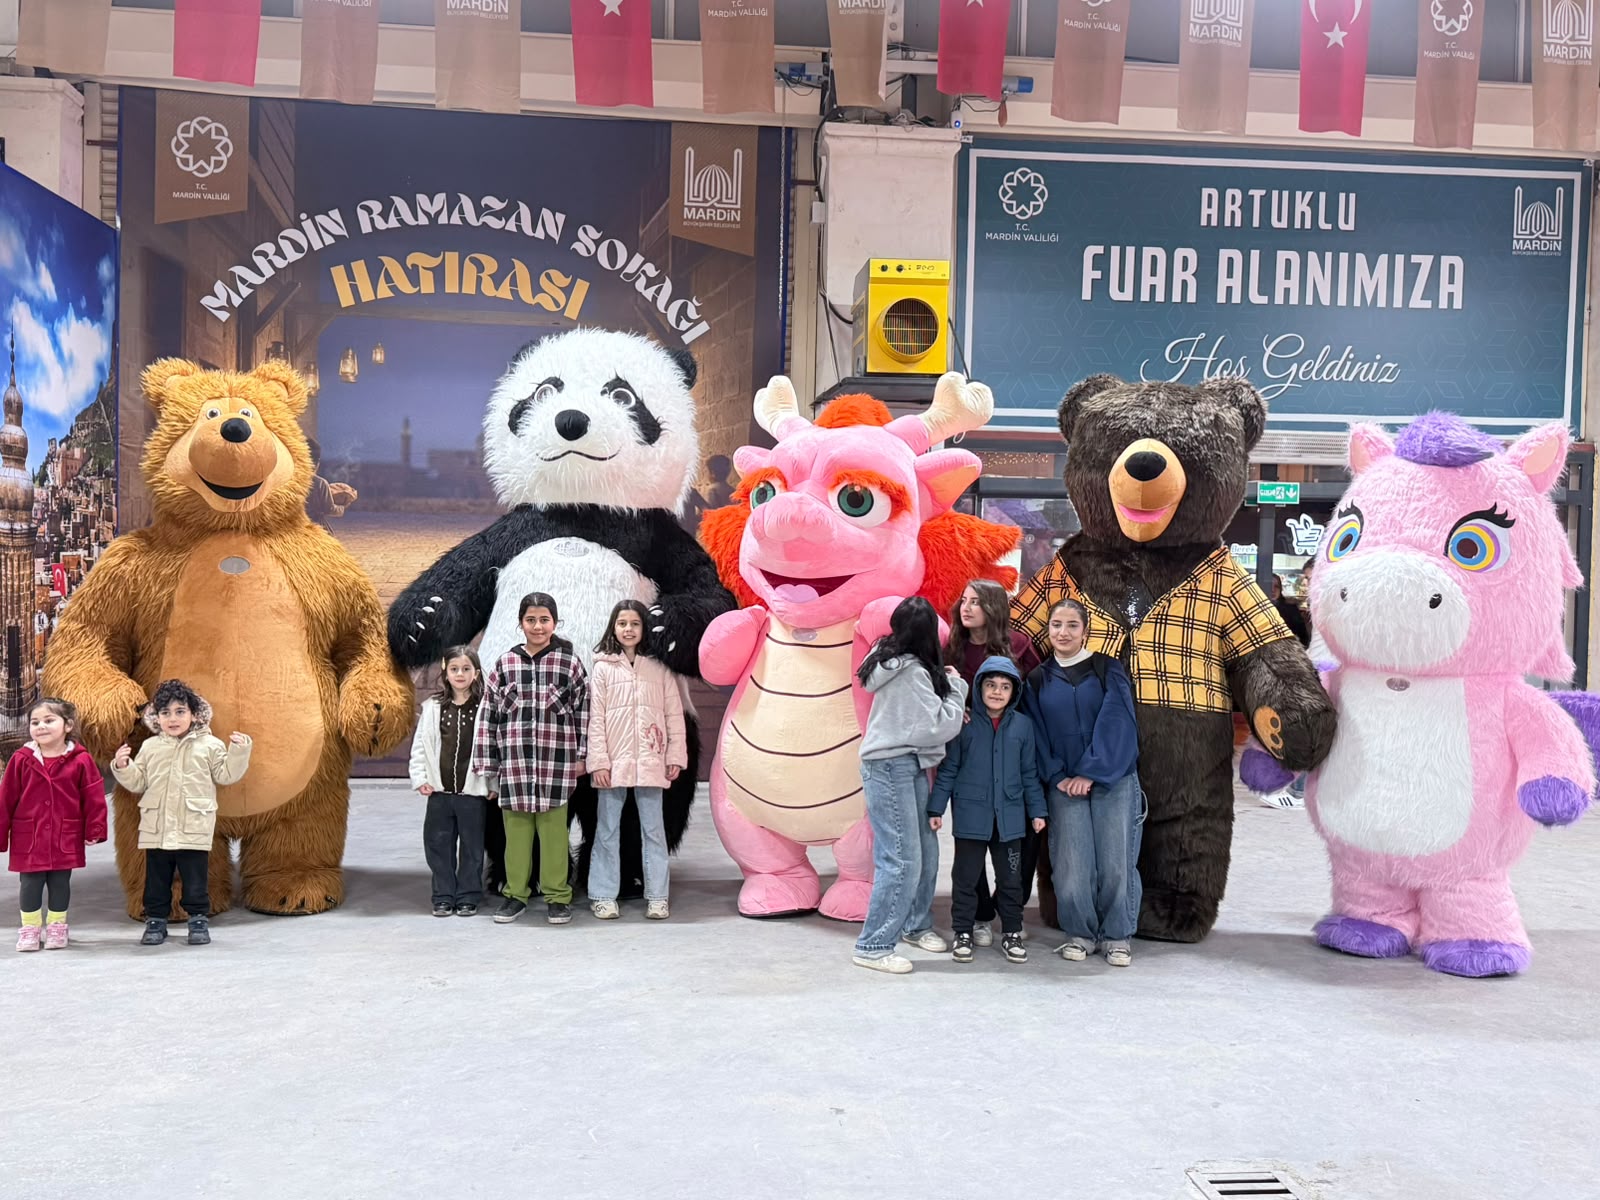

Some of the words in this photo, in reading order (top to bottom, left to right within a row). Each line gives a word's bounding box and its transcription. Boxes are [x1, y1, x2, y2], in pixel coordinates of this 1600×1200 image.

[708, 9, 737, 17] MARDİN
[738, 8, 768, 16] VALİLİĞİ
[1064, 18, 1091, 29] MARDİN
[1423, 50, 1450, 59] MARDİN
[195, 183, 207, 191] T.C.
[172, 191, 201, 199] MARDİN
[202, 192, 230, 201] VALİLİĞİ
[1200, 187, 1357, 231] ARTUKLU
[1015, 223, 1030, 231] T.C.
[985, 231, 1021, 241] MARDİN
[1023, 232, 1059, 243] VALİLİĞİ
[199, 208, 349, 322] MARDİN
[356, 192, 566, 244] RAMAZAN
[570, 224, 711, 345] SOKAĞI
[1081, 245, 1199, 304] FUAR
[1216, 248, 1465, 310] ALANIMIZA
[330, 251, 590, 321] HATIRASI
[1259, 333, 1401, 401] Geldiniz
